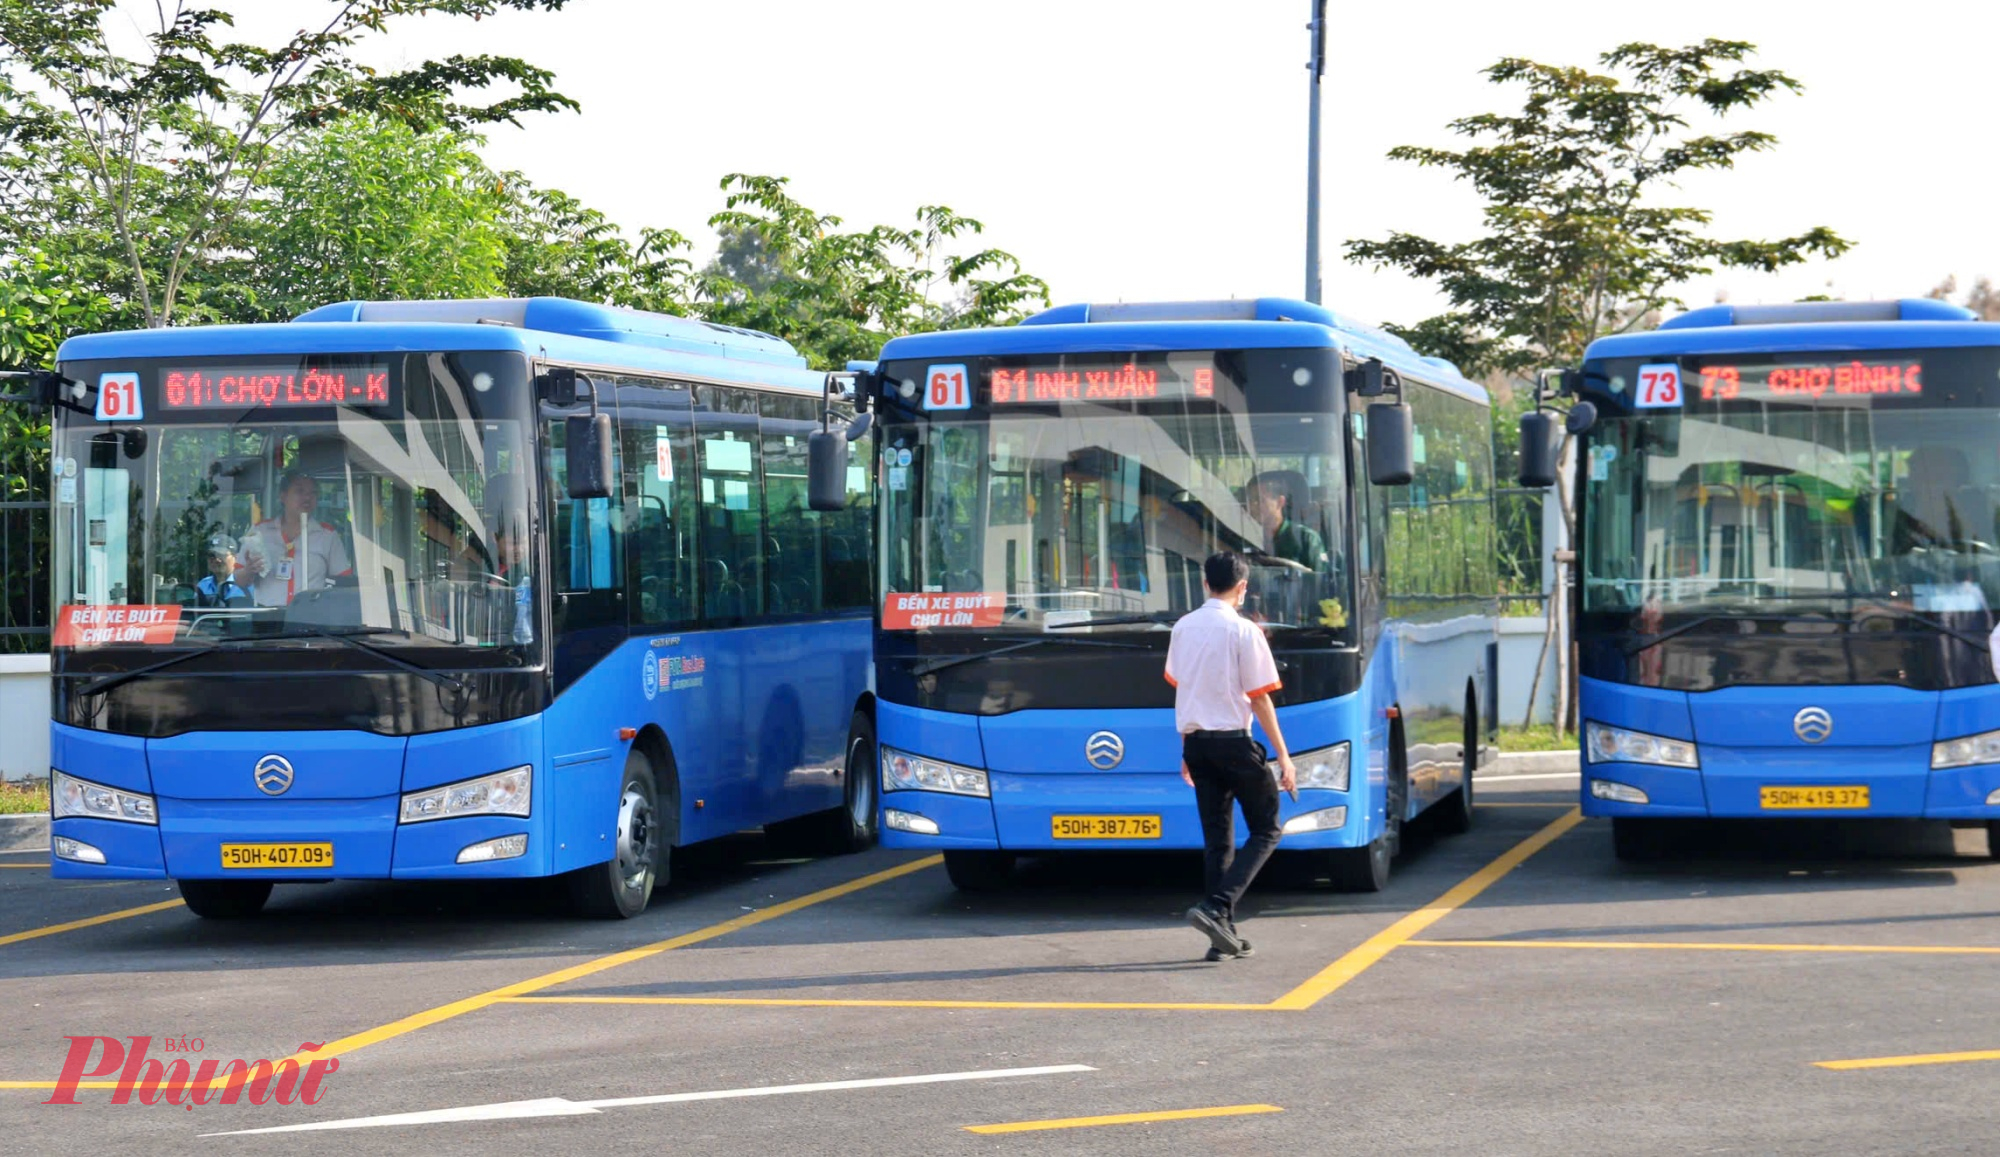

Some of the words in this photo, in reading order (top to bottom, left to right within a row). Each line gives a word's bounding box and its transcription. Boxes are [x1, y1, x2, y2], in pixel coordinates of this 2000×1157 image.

[166, 371, 201, 406] 61
[218, 374, 281, 408] CHỢ
[287, 368, 345, 402] LỚN
[367, 372, 386, 401] K
[931, 372, 963, 406] 61
[992, 368, 1028, 402] 61
[1641, 372, 1677, 403] 73
[1700, 365, 1740, 399] 73
[1768, 367, 1831, 398] CHỢ
[1834, 360, 1900, 394] BÌNH
[103, 381, 135, 415] 61
[659, 446, 671, 477] 61
[70, 606, 102, 624] BẾN
[105, 609, 125, 623] XE
[897, 593, 928, 610] BẾN
[931, 597, 950, 610] XE
[1769, 790, 1859, 805] 50H-419.37
[1060, 819, 1151, 835] 50H-387.76
[231, 847, 323, 864] 50H-407.09
